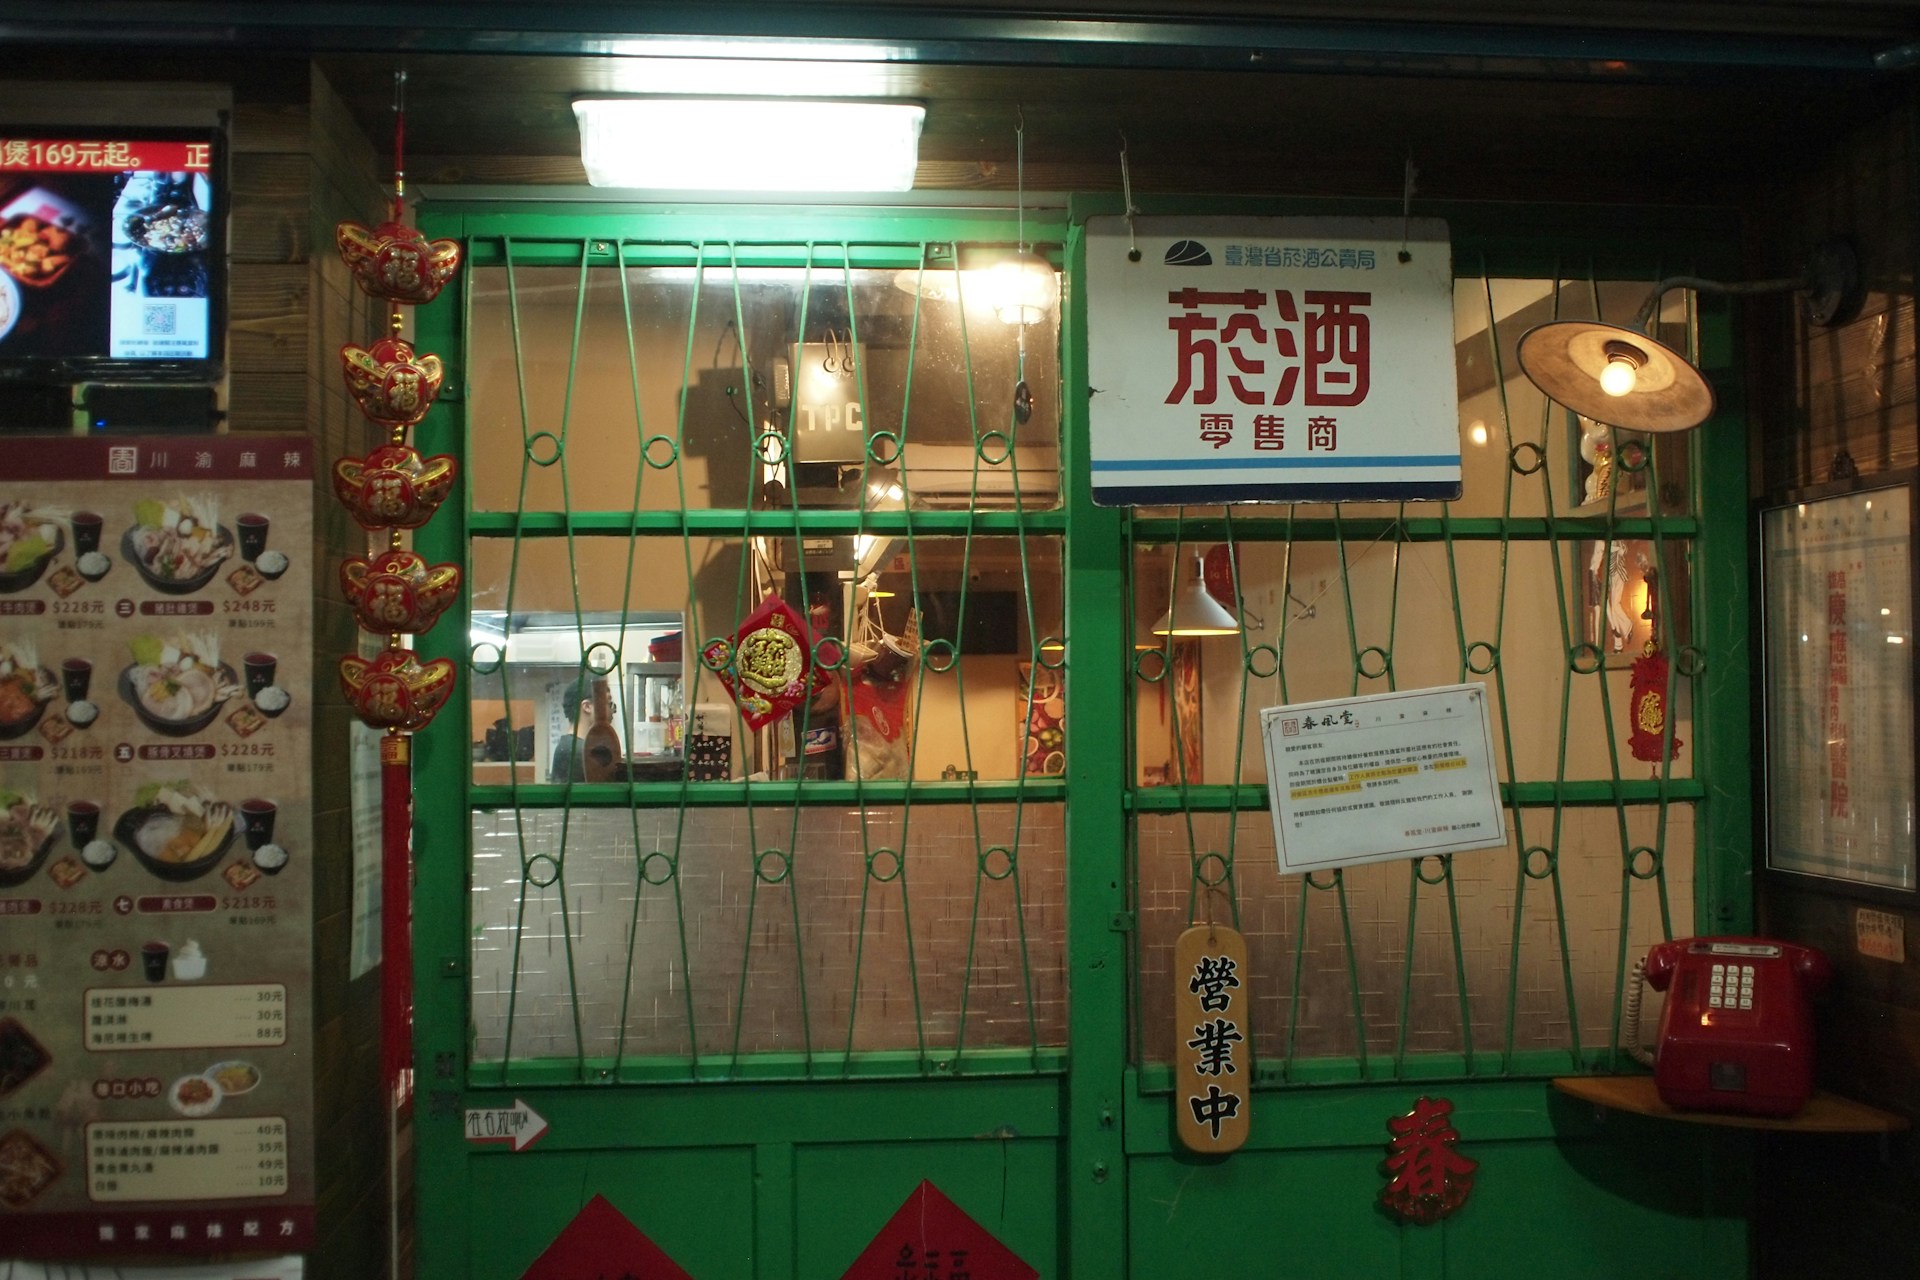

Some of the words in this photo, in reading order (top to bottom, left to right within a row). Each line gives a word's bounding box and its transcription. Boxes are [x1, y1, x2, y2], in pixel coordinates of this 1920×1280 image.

[0, 141, 141, 166] 煲169元起。
[1224, 245, 1376, 270] 臺灣省菸酒公賣局
[1164, 287, 1372, 407] 菸酒
[1200, 413, 1337, 451] 零售商
[223, 600, 276, 612] $248元
[1300, 710, 1354, 730] 春風堂
[221, 743, 274, 756] $228元
[222, 896, 276, 909] $218元
[257, 991, 283, 1001] 30元
[257, 1010, 283, 1021] 30元
[1188, 955, 1244, 1139] 營業中
[1381, 1097, 1479, 1196] 春
